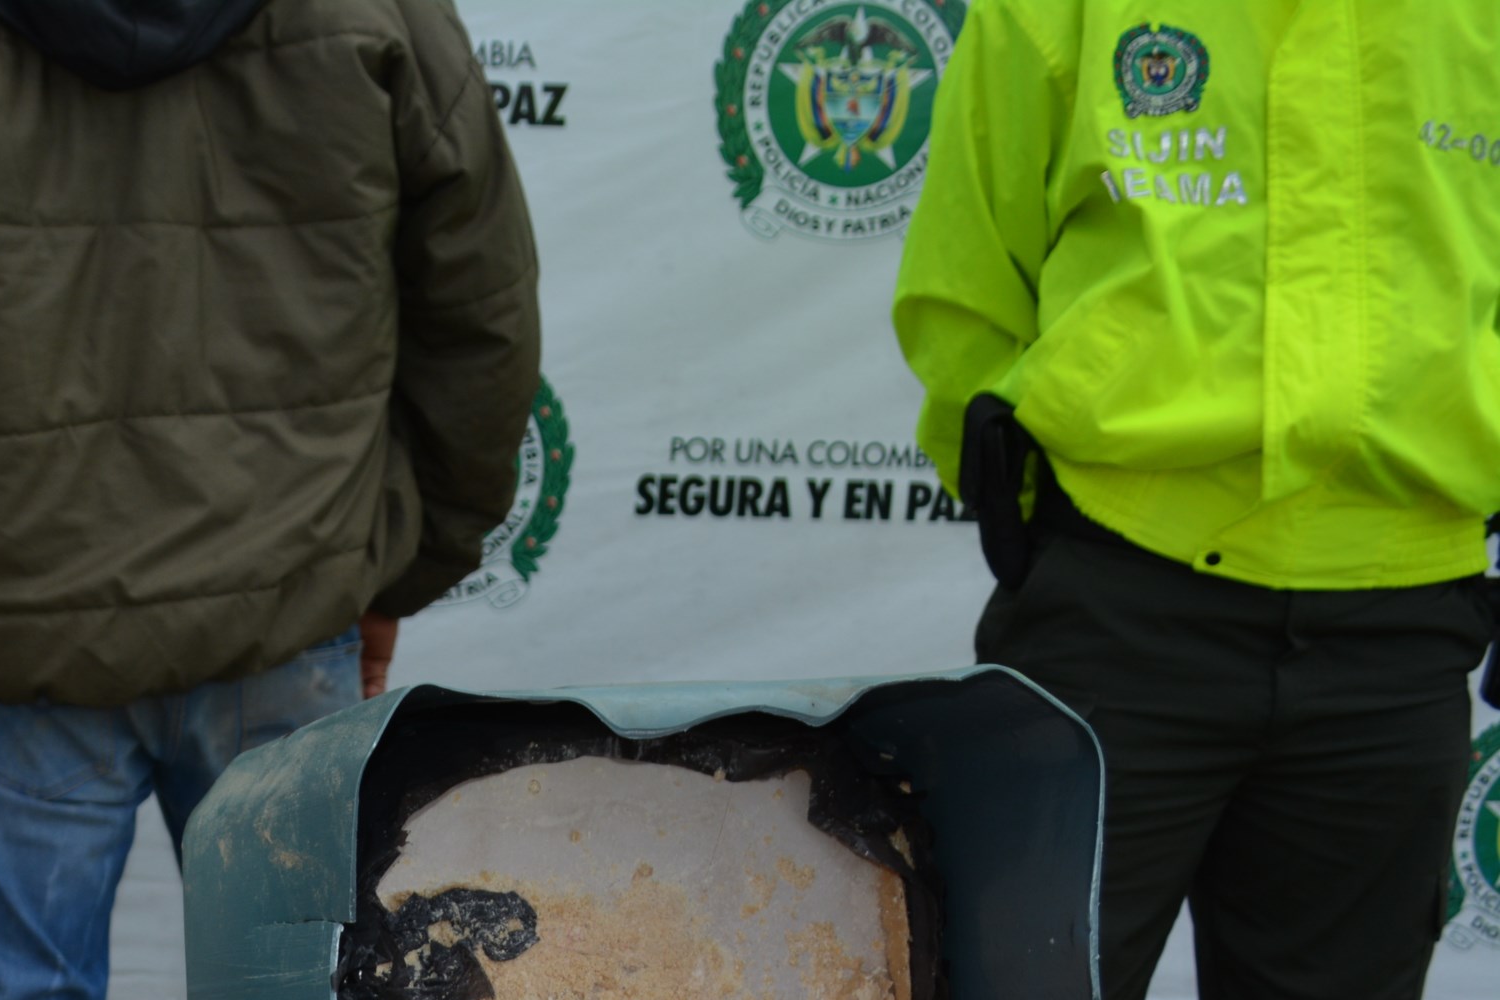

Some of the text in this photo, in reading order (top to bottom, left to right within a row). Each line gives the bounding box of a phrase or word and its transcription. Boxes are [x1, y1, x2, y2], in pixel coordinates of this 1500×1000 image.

[1107, 126, 1226, 164] SIJIN
[668, 436, 726, 464] POR
[734, 439, 799, 466] UNA
[634, 474, 790, 518] SEGURA
[807, 479, 832, 518] Y
[843, 479, 893, 520] EN
